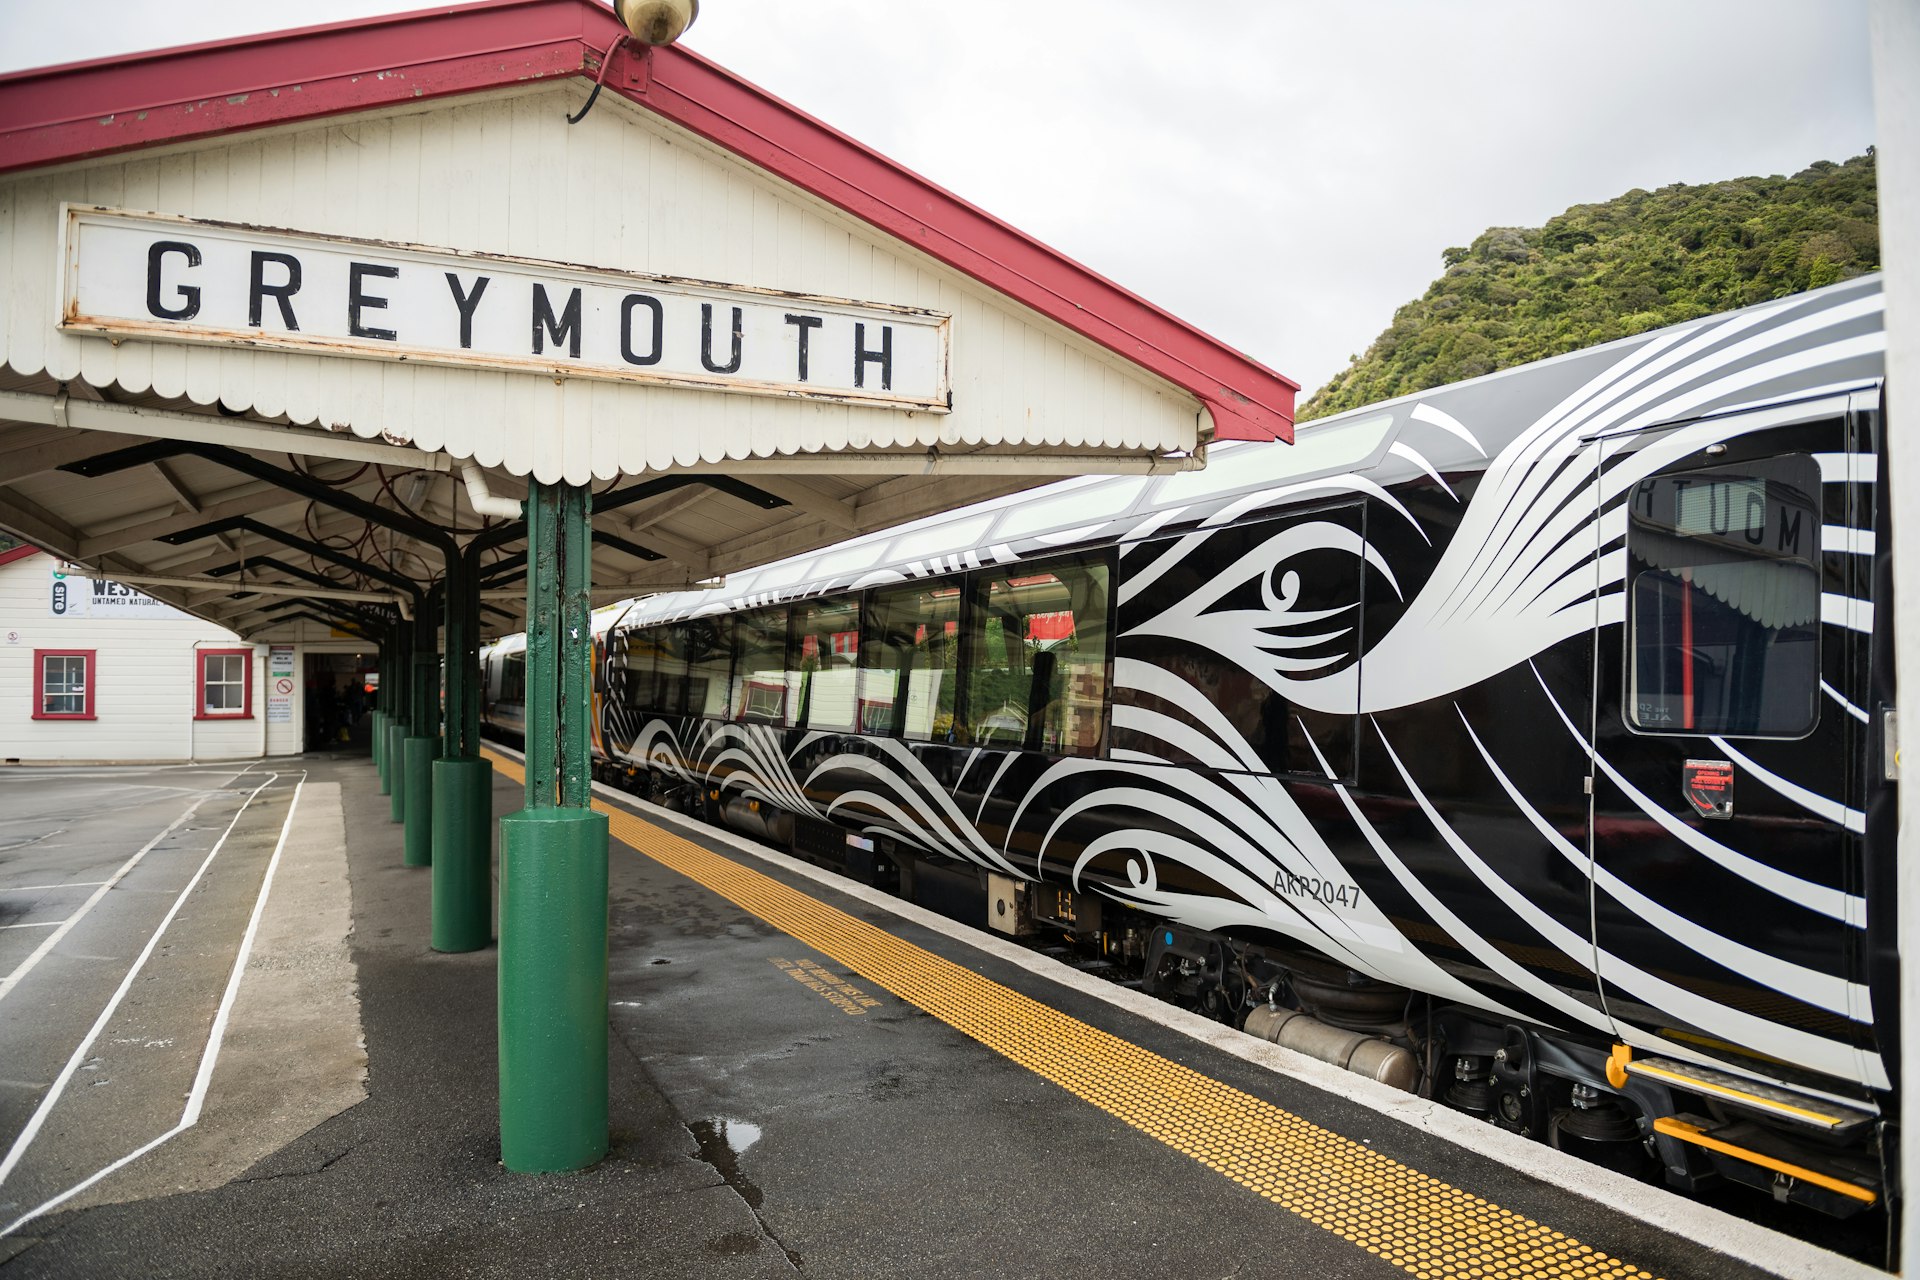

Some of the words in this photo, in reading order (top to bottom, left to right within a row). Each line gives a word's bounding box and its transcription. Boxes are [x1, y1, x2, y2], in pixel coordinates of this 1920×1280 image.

[147, 240, 893, 391] GREYMOUTH
[92, 597, 126, 605] UNTAMED
[129, 598, 160, 607] NATURAL
[1273, 870, 1360, 909] AKP2047
